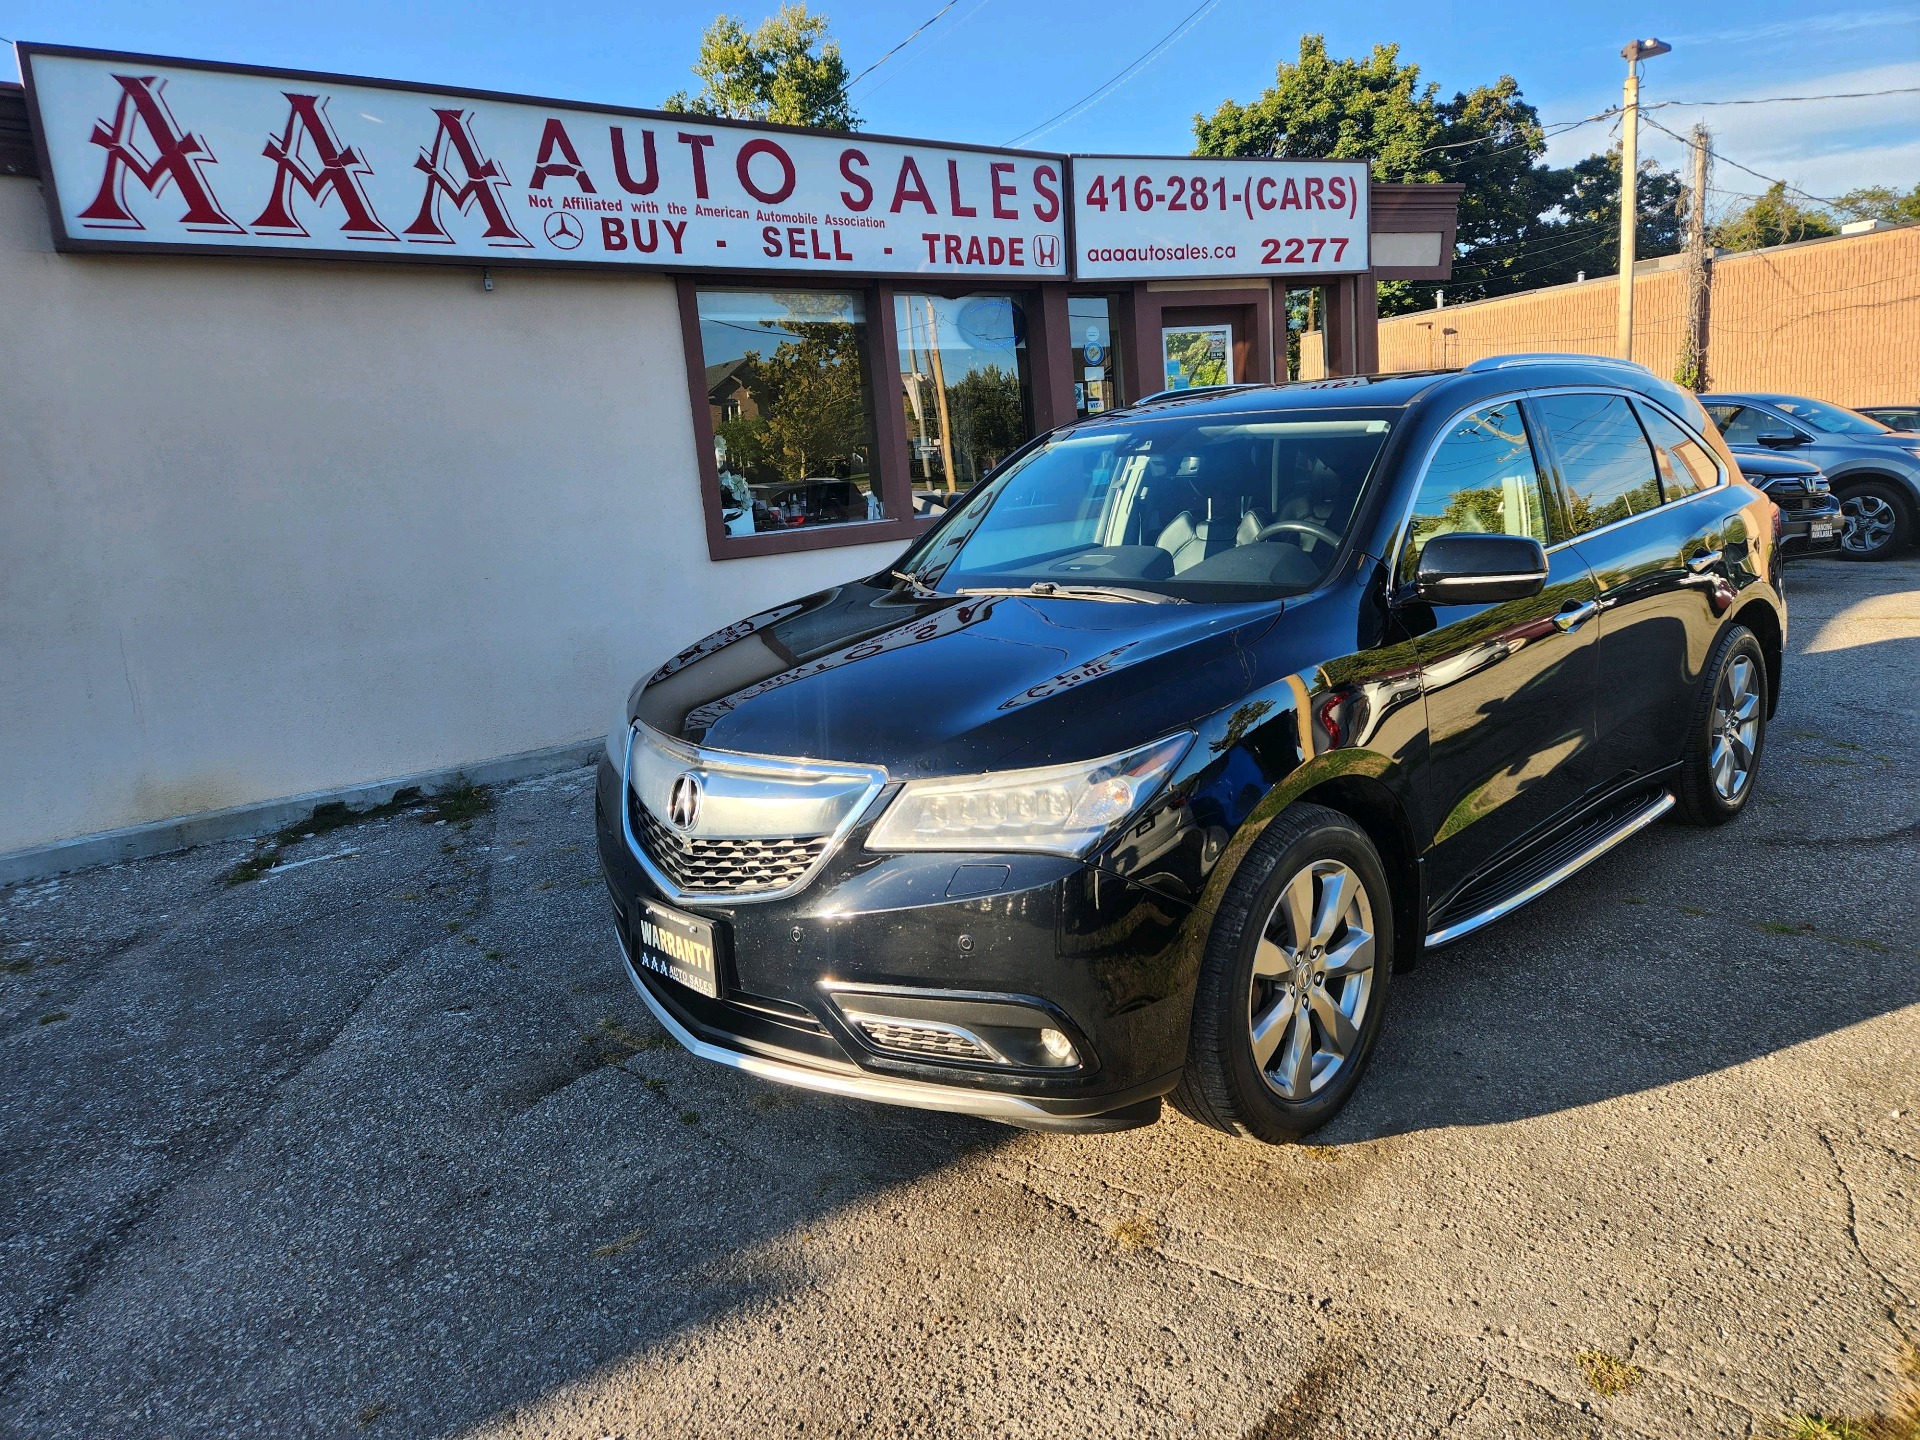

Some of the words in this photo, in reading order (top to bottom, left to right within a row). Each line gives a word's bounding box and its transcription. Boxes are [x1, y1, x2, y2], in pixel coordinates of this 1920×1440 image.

[528, 118, 796, 204] AUTO
[839, 148, 1060, 223] SALES
[528, 194, 554, 209] Not
[562, 196, 623, 212] Affiliated
[631, 201, 659, 214] with
[667, 202, 688, 215] the
[695, 204, 750, 219] American
[756, 209, 818, 225] Automobile
[825, 213, 885, 229] Association
[1086, 174, 1357, 220] 416-281-(CARS)
[601, 216, 688, 254] BUY
[762, 226, 853, 261] SELL
[922, 233, 1025, 266] TRADE
[1087, 243, 1236, 263] aaaautosales.ca
[1261, 237, 1349, 265] 2277
[640, 919, 711, 972] WARRANTY
[669, 965, 688, 981] AUTO
[689, 974, 713, 994] SALES
